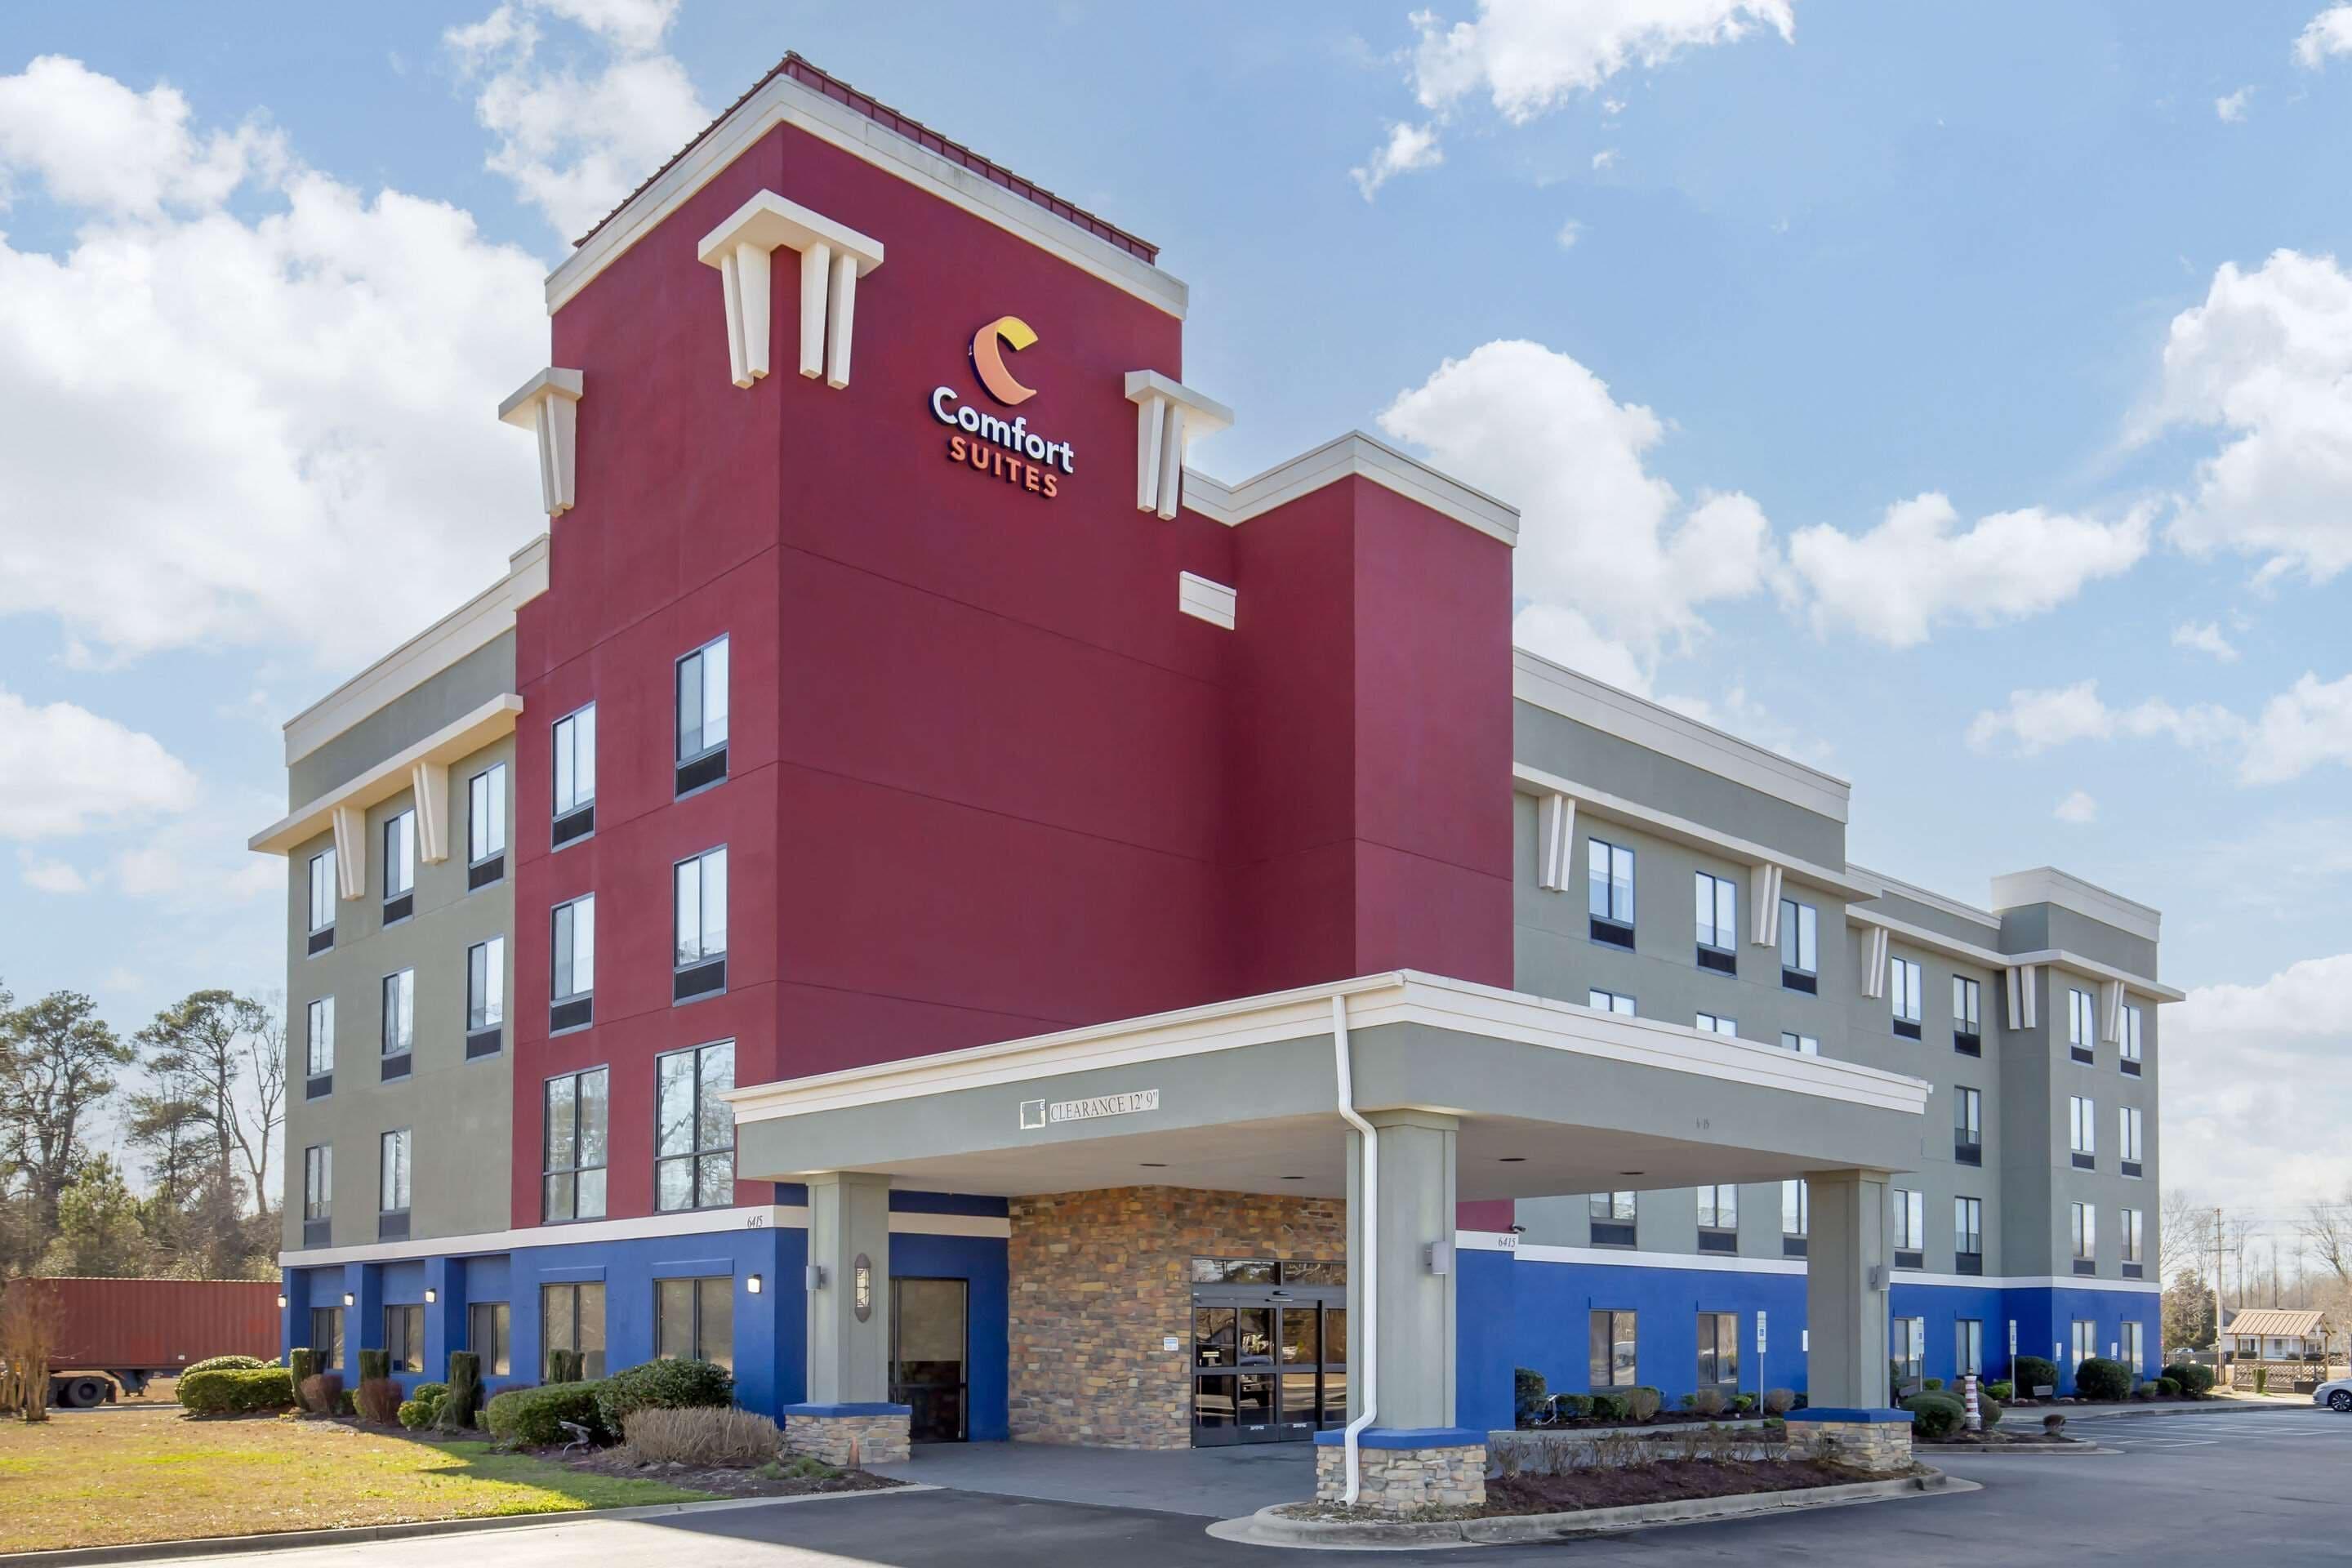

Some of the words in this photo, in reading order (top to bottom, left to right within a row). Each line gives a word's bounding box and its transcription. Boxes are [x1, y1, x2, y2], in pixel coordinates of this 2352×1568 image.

[930, 385, 1075, 474] Comfort
[949, 435, 1058, 497] SUITES
[1050, 1096, 1126, 1121] CLEARANCE
[747, 1215, 764, 1228] 6415
[1498, 1236, 1516, 1248] 6415
